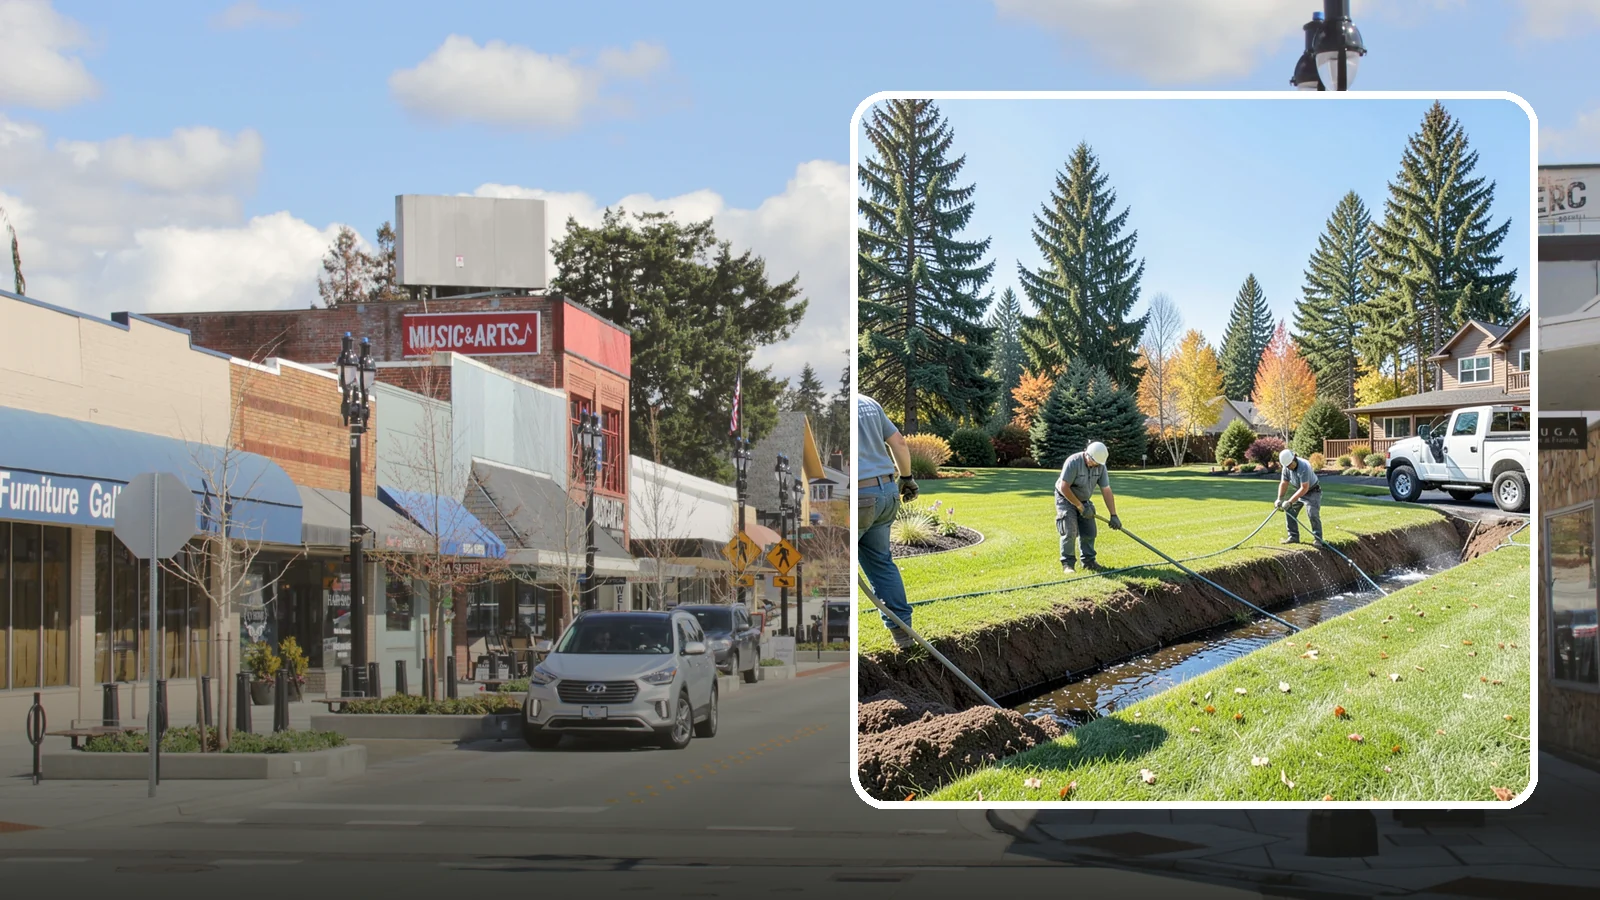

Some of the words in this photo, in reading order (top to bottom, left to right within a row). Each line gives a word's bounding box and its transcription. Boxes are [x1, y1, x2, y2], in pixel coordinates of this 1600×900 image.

[1538, 181, 1587, 213] ERC
[409, 323, 519, 348] MUSIC&ARTS
[1540, 427, 1577, 436] UGA
[0, 472, 79, 514] Furniture
[89, 482, 122, 519] Gal
[453, 563, 479, 574] SUSHI
